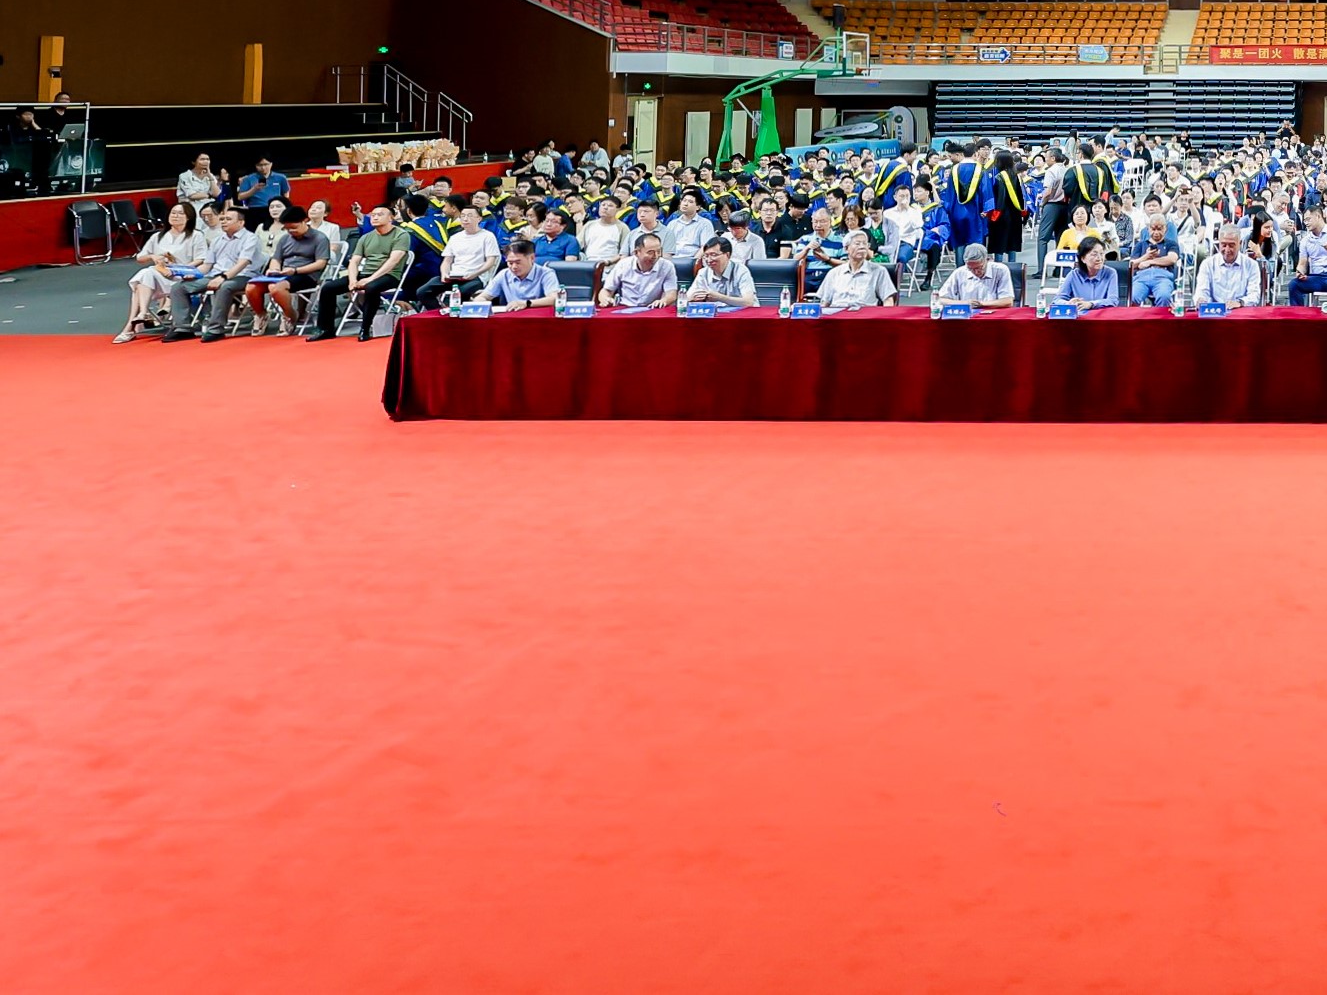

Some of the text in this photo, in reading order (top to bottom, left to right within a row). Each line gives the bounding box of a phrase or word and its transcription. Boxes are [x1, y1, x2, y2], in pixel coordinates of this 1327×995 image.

[1219, 48, 1282, 59] 聚是一团火
